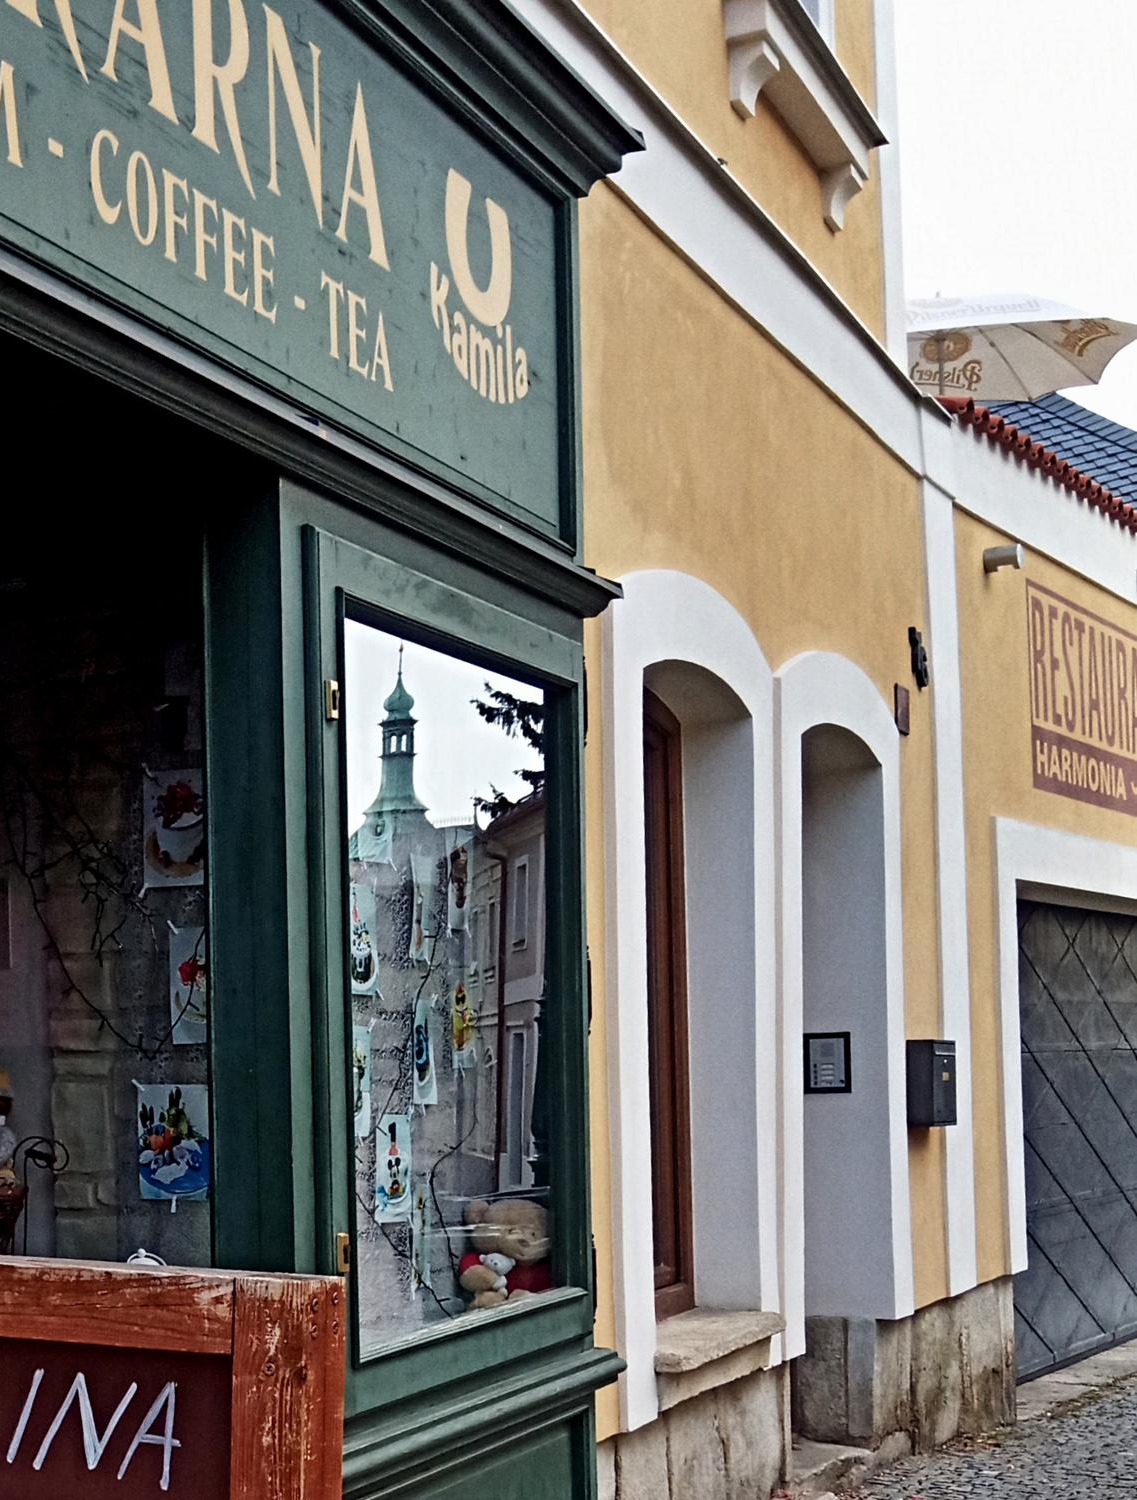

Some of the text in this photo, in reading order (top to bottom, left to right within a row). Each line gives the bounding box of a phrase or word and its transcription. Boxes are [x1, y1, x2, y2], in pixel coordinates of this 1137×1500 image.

[3, 0, 390, 271] ARNA
[91, 129, 278, 323] COFFEE
[320, 271, 394, 392] TEA
[430, 262, 529, 404] Kamila
[1036, 739, 1127, 801] HARMONIA
